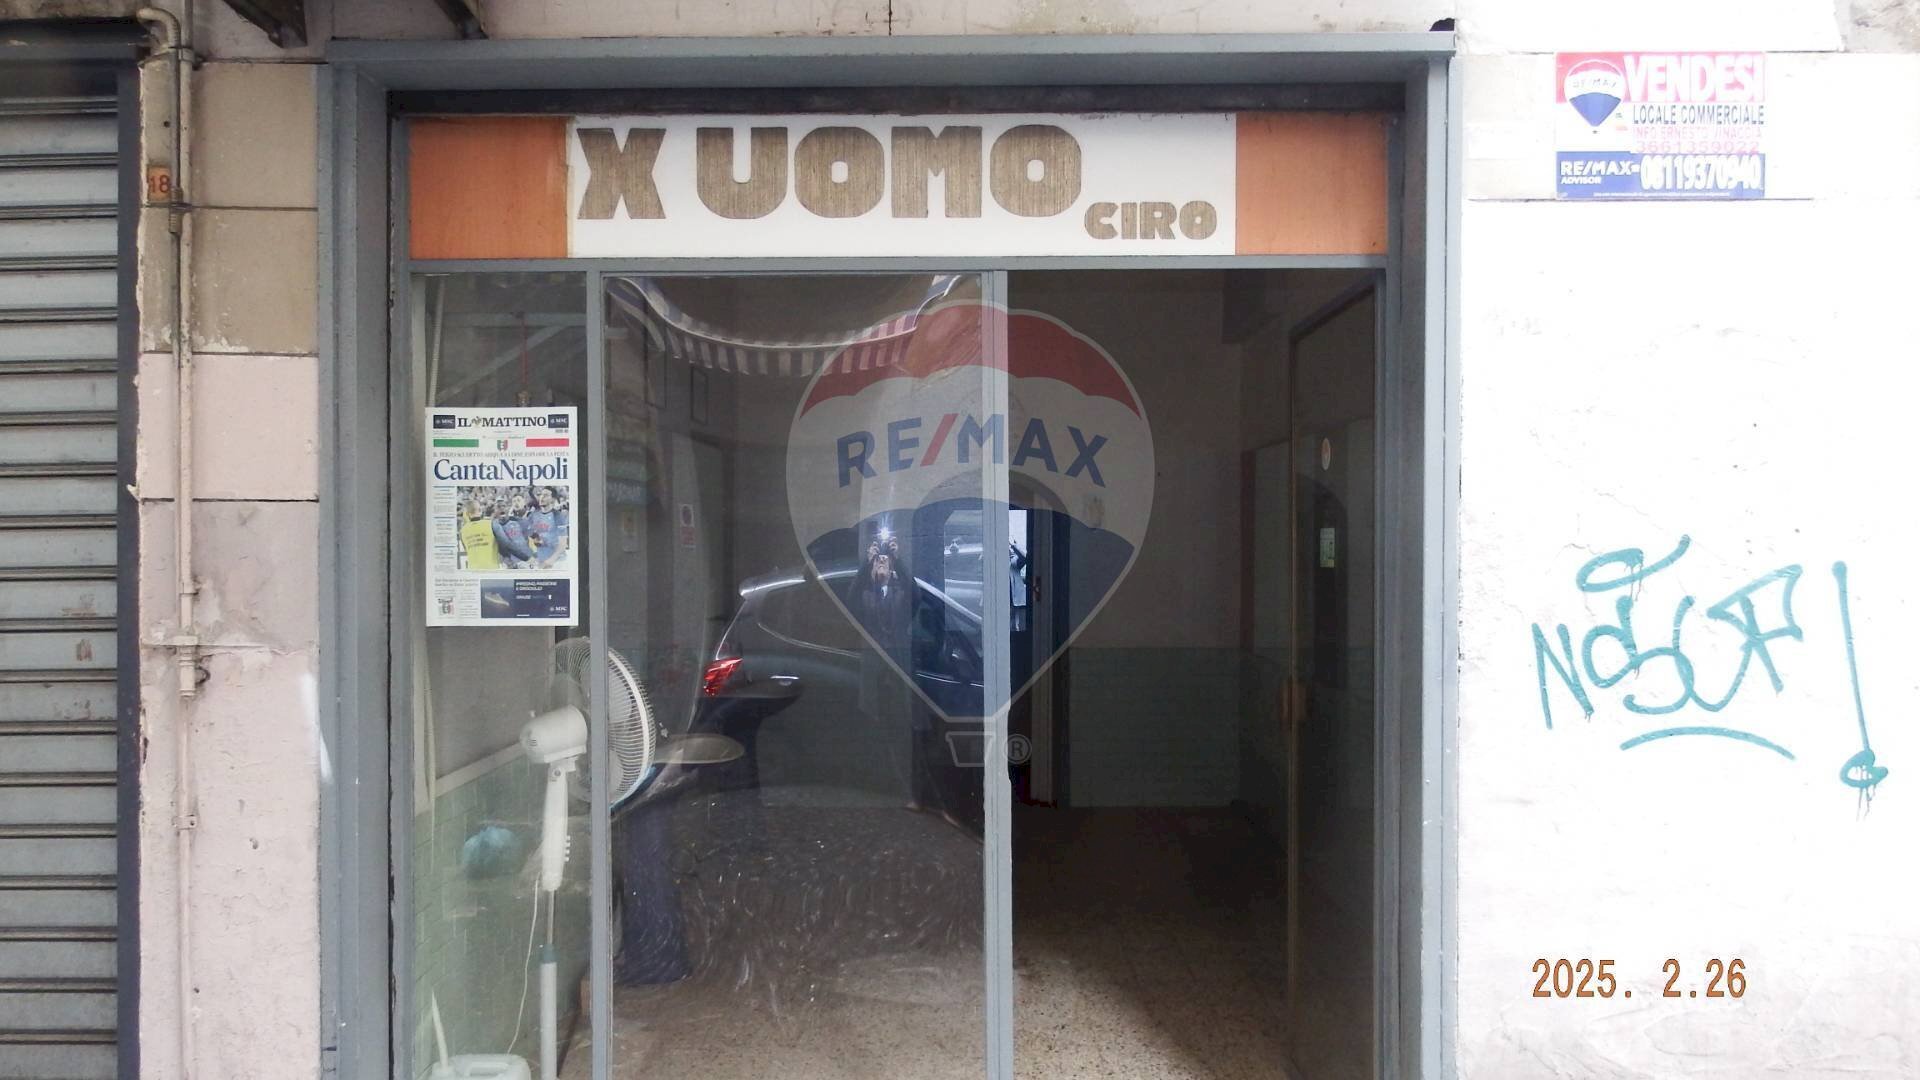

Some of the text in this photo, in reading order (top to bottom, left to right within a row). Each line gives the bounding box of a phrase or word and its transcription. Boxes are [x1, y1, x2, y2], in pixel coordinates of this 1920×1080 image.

[1623, 54, 1765, 102] VENDESI
[1633, 105, 1765, 125] LOCALE COMMERCIALE
[577, 125, 1082, 220] X UOMO
[1560, 160, 1632, 176] RE/MAX
[150, 174, 170, 193] 18
[1560, 176, 1602, 185] ADVISOR
[1084, 200, 1217, 240] CIRO
[457, 416, 547, 428] IL MATTINO
[434, 457, 569, 486] CantaNapoli
